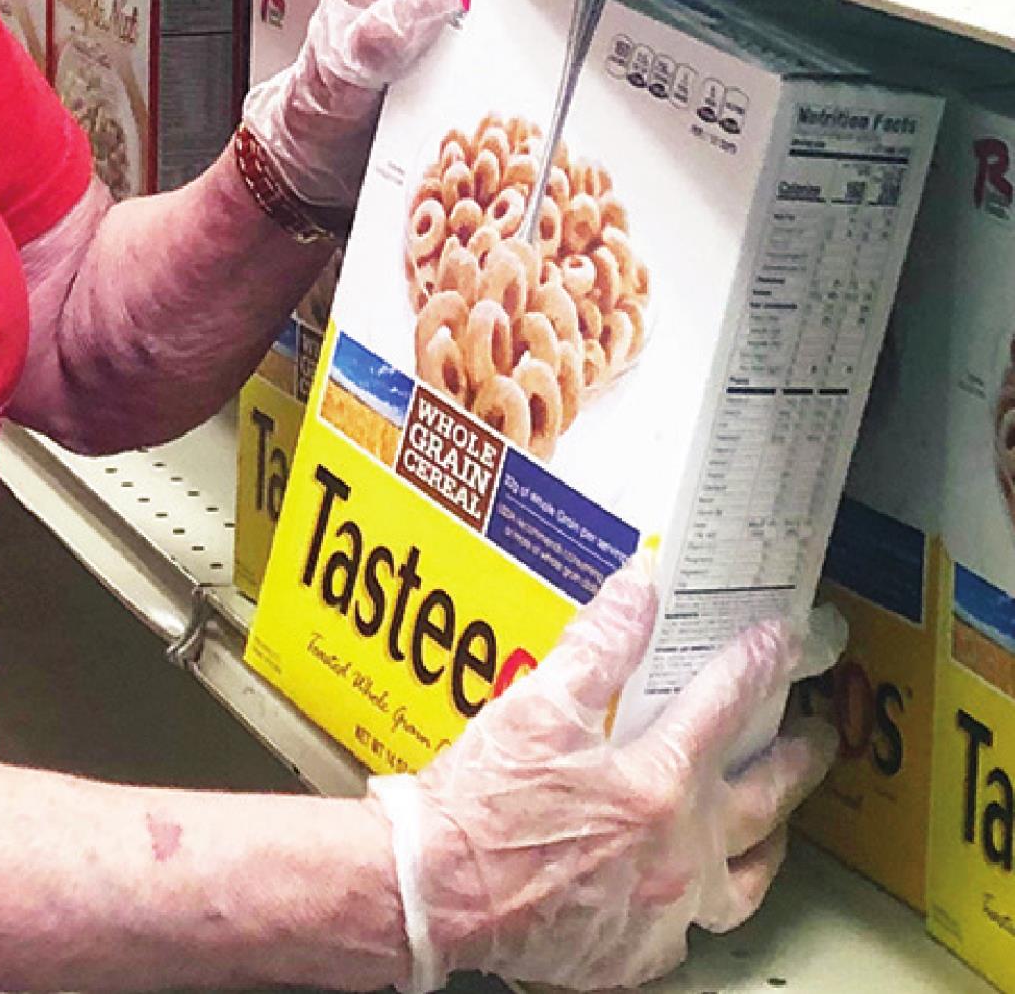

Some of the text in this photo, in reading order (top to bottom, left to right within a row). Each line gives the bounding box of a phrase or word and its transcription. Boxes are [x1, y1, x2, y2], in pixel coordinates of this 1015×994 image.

[795, 104, 918, 136] Nutrition Facts
[409, 422, 492, 495] GRAIN
[418, 397, 496, 469] WHOLE
[404, 448, 482, 519] CEREAL
[957, 708, 1014, 873] Ta
